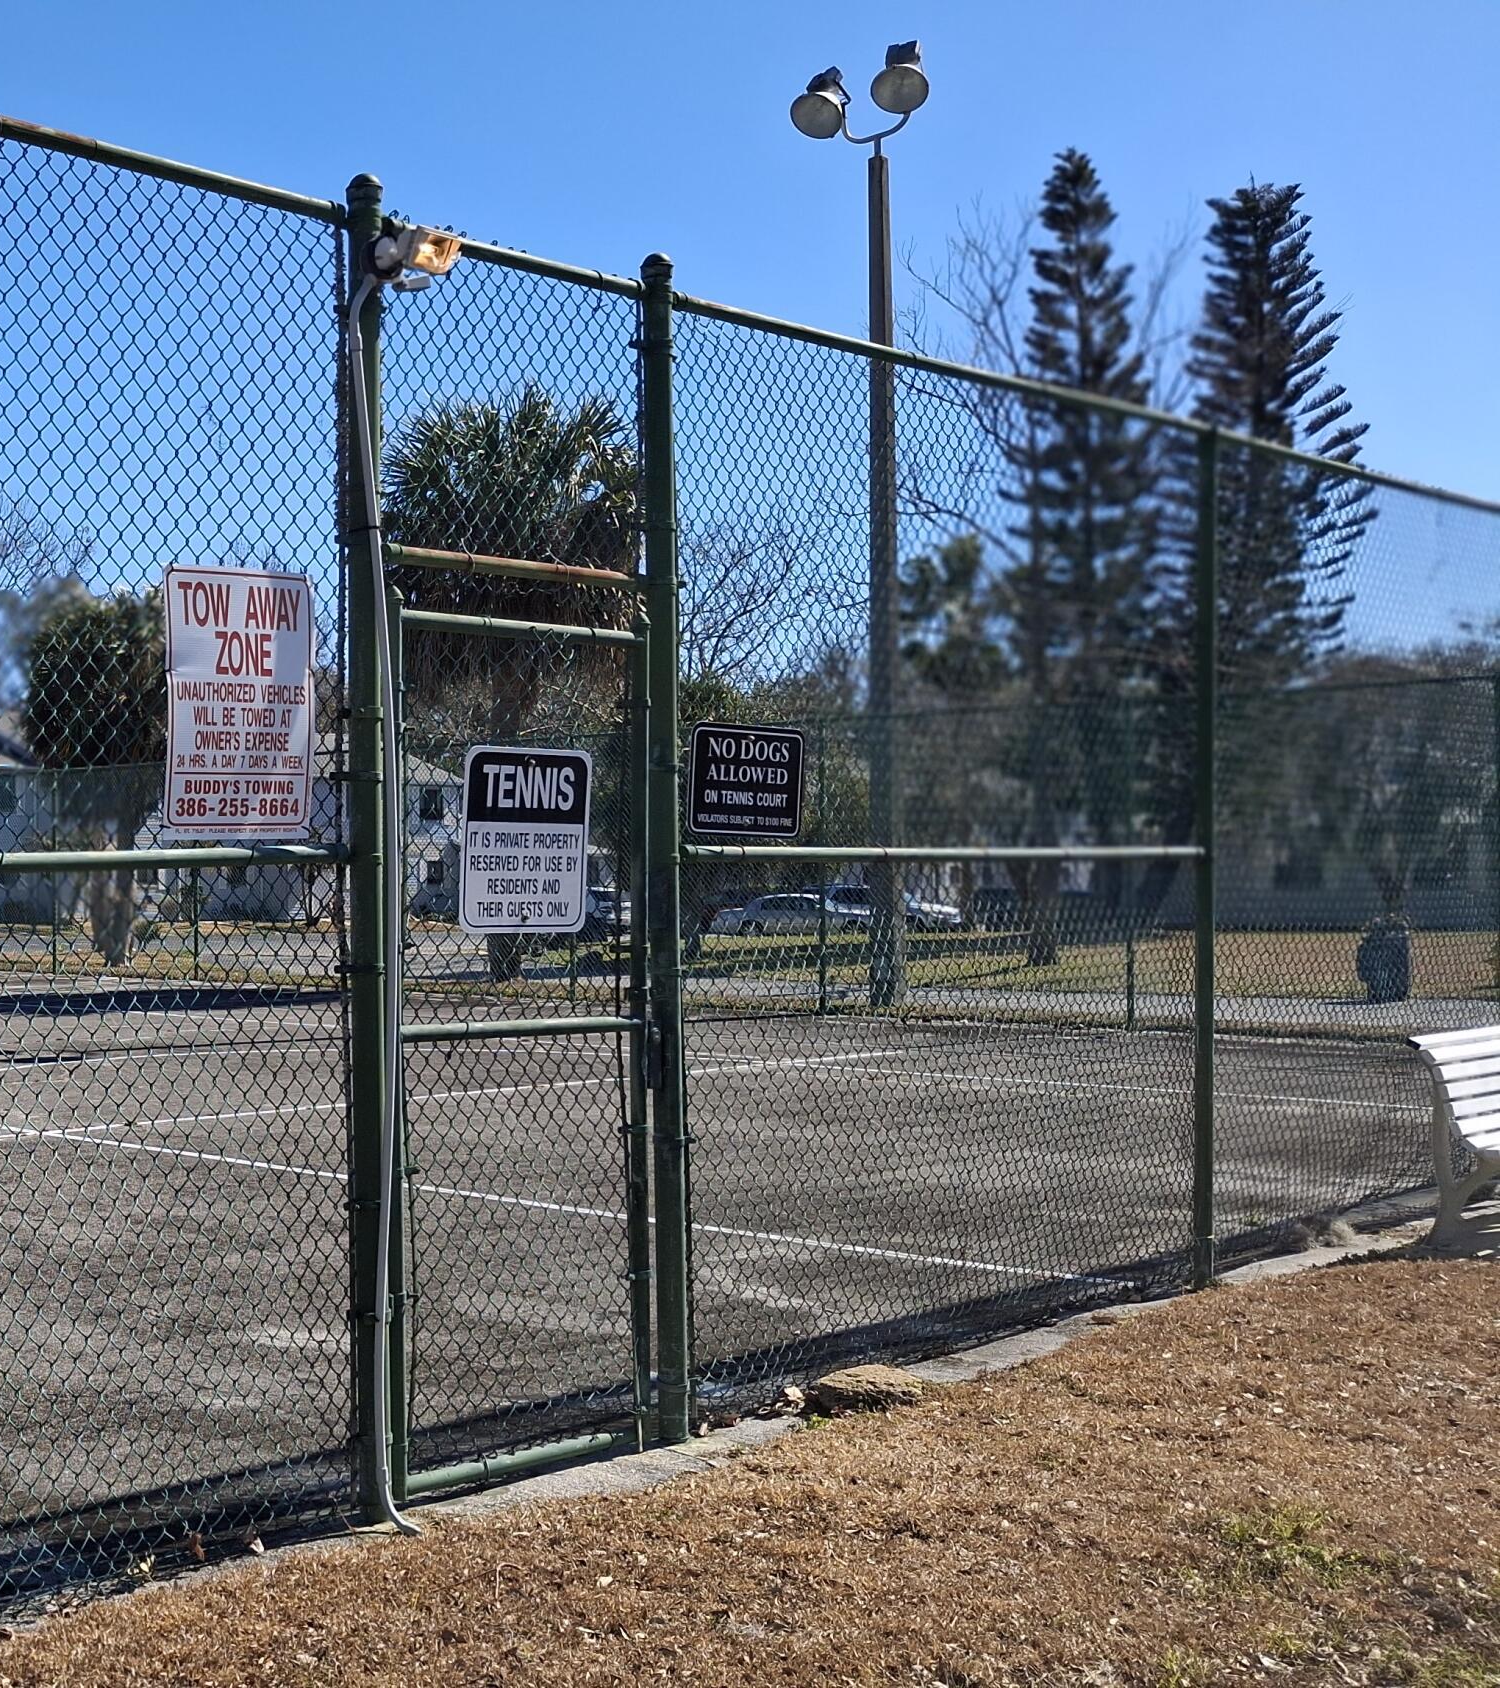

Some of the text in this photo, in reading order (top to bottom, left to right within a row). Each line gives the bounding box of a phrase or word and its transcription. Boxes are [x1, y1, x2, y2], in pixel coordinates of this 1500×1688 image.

[177, 581, 301, 632] TOW AWAY
[215, 631, 273, 677] ZONE
[176, 681, 306, 705] UNAUTHORIZED VEHICLES
[193, 706, 292, 728] WILL BE TOWED AT
[194, 730, 289, 752] OWNER'S EXPENSE
[708, 736, 790, 763] NO DOGS
[176, 754, 304, 770] 24 HRS. A DAY 7 DAYS A WEEK
[706, 763, 788, 785] ALLOWED
[184, 779, 294, 795] BUDDY'S TOWING
[482, 764, 575, 811] TENNIS
[704, 789, 788, 808] ON TENNIS COURT
[697, 813, 729, 824] VIOLATORS
[757, 816, 764, 826] TO
[780, 818, 793, 827] FINE
[469, 831, 581, 849] IT IS PRIVATE PROPERTY
[469, 855, 579, 872] RESERVED FOR USE BY
[487, 878, 561, 895] RESIDENTS AND
[477, 901, 570, 918] THEIR GUESTS ONLY
